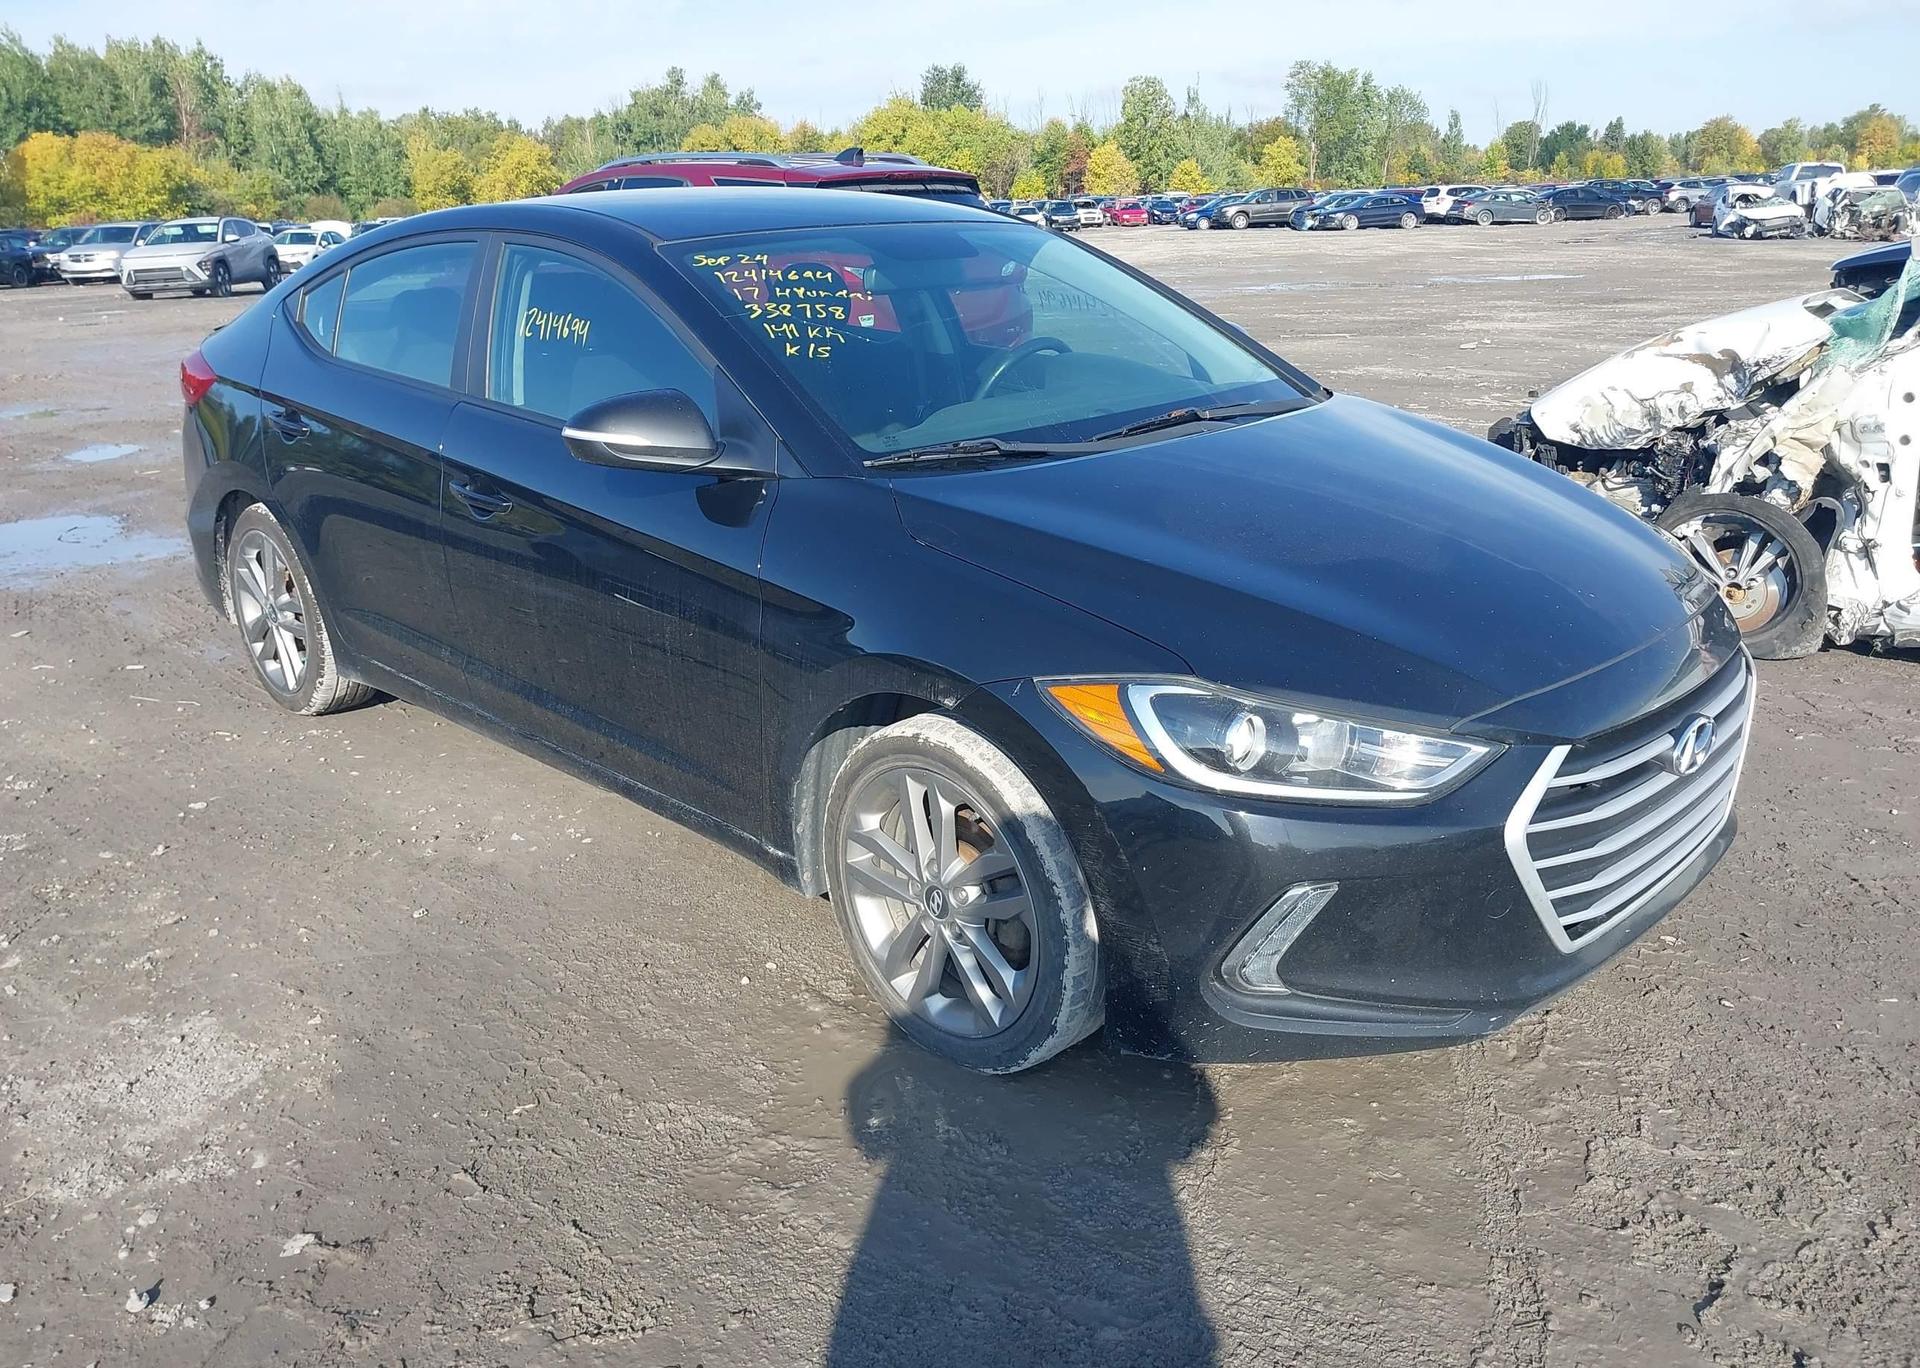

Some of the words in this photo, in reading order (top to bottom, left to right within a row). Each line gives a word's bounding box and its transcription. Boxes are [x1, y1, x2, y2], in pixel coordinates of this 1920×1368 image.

[737, 254, 768, 266] 24
[714, 268, 833, 284] 12414694
[733, 287, 760, 301] 17
[744, 302, 846, 320] 338758
[519, 307, 591, 348] 12414694
